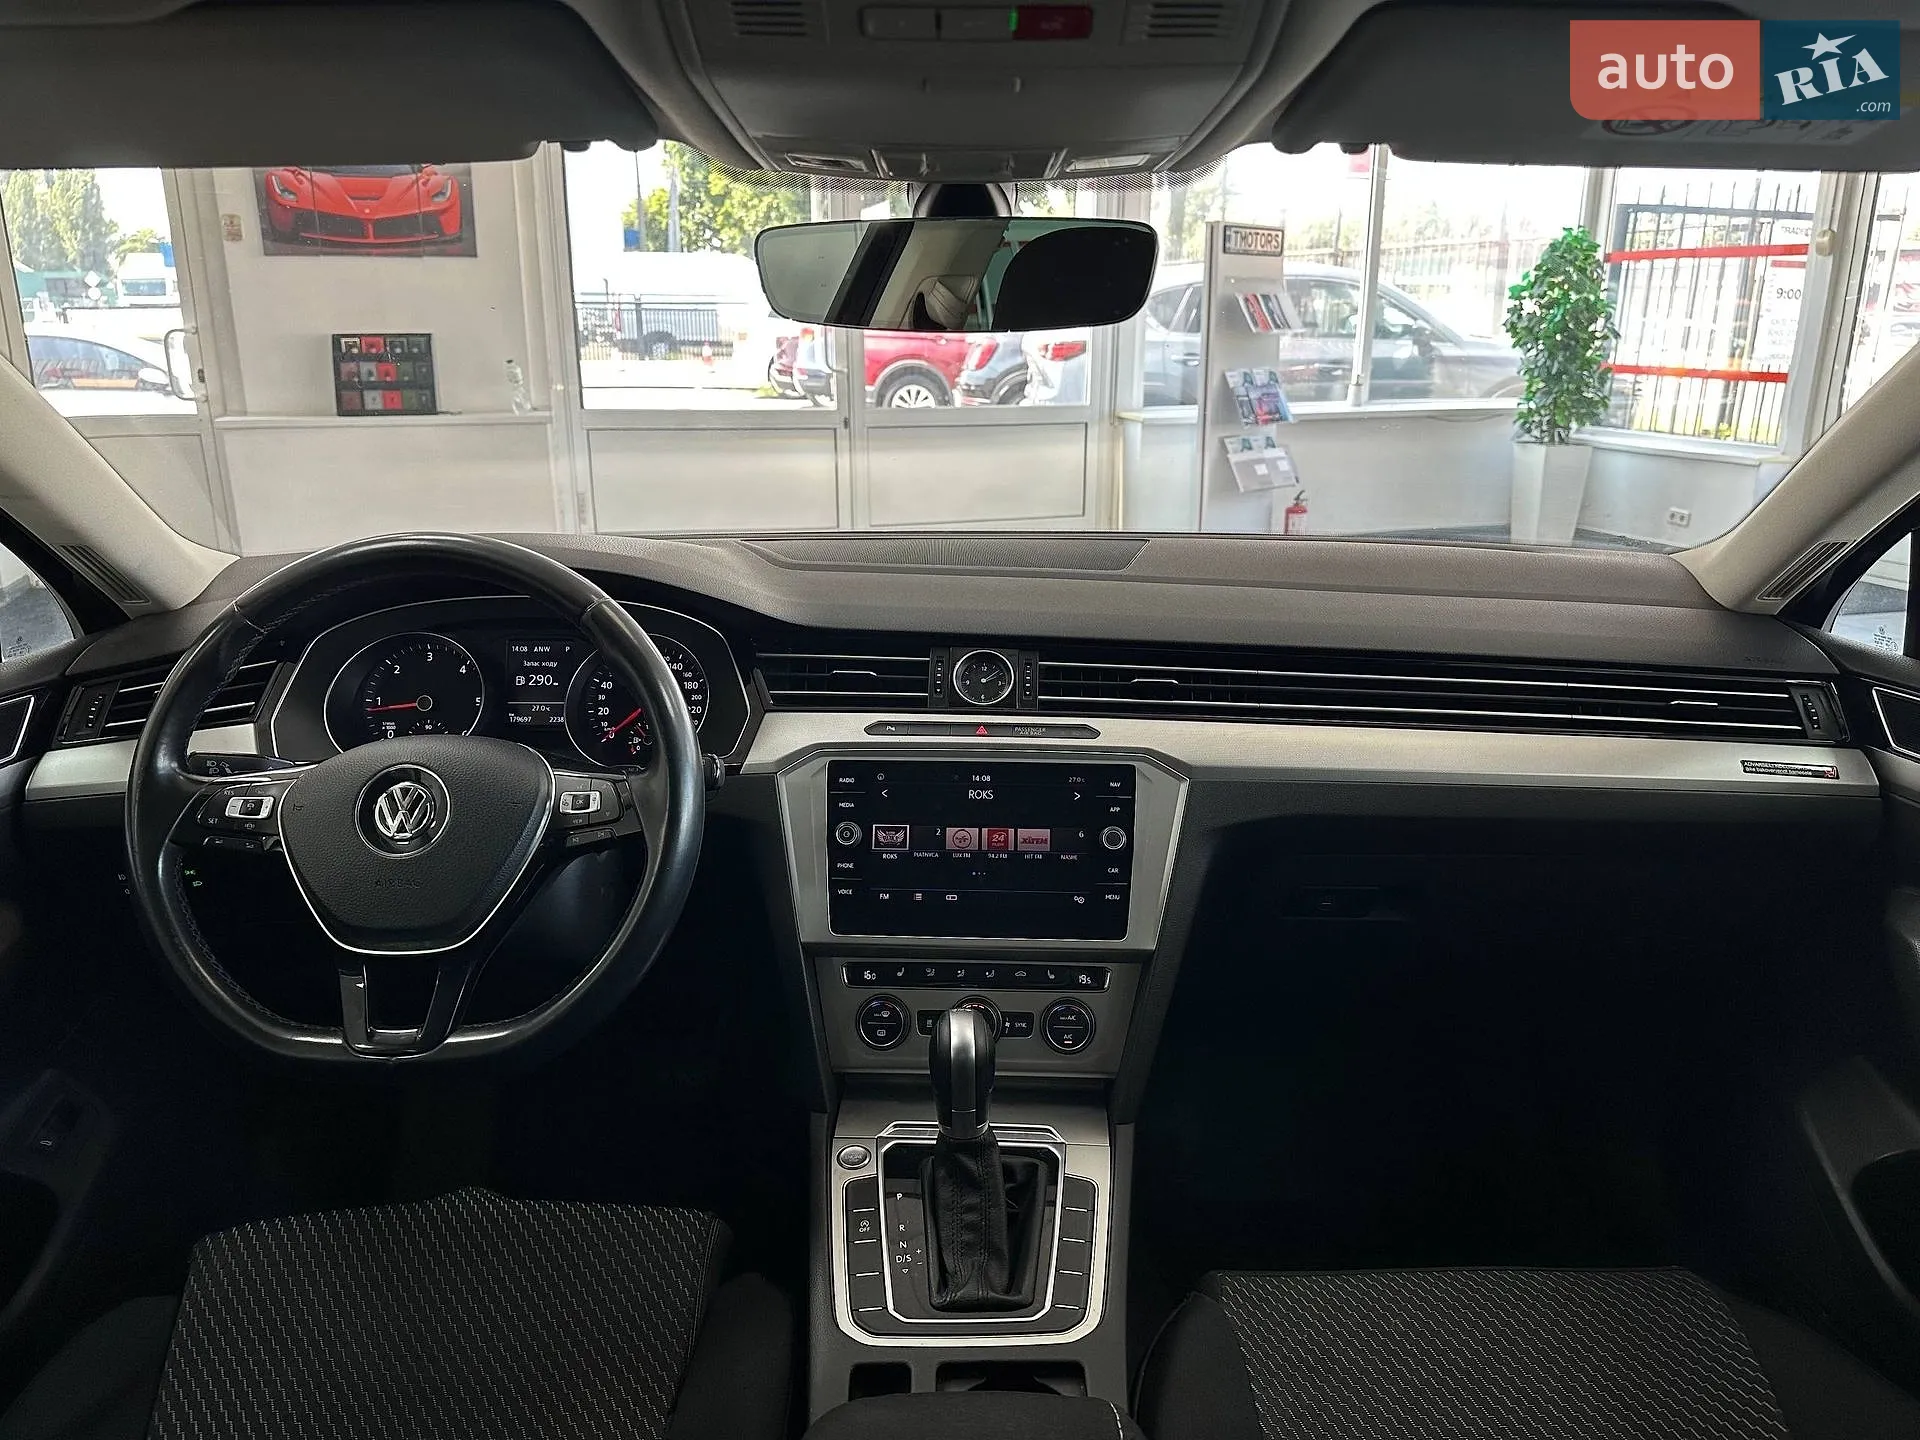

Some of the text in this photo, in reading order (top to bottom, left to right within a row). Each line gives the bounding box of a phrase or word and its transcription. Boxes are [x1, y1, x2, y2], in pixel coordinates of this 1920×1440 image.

[1233, 230, 1280, 250] TMOTORS
[427, 652, 433, 661] 3
[393, 664, 401, 674] 2
[459, 665, 467, 674] 4
[528, 674, 553, 686] 290
[684, 682, 699, 690] 180
[376, 696, 381, 705] 1
[475, 697, 481, 706] 5
[598, 707, 610, 715] 20
[387, 730, 395, 739] 0
[972, 774, 991, 782] 14:08
[968, 789, 994, 800] ROKS
[936, 828, 941, 836] 2
[1079, 830, 1084, 838] 6
[991, 834, 1004, 842] 24
[899, 1224, 905, 1232] R
[899, 1241, 907, 1249] N
[895, 1254, 912, 1263] D/S
